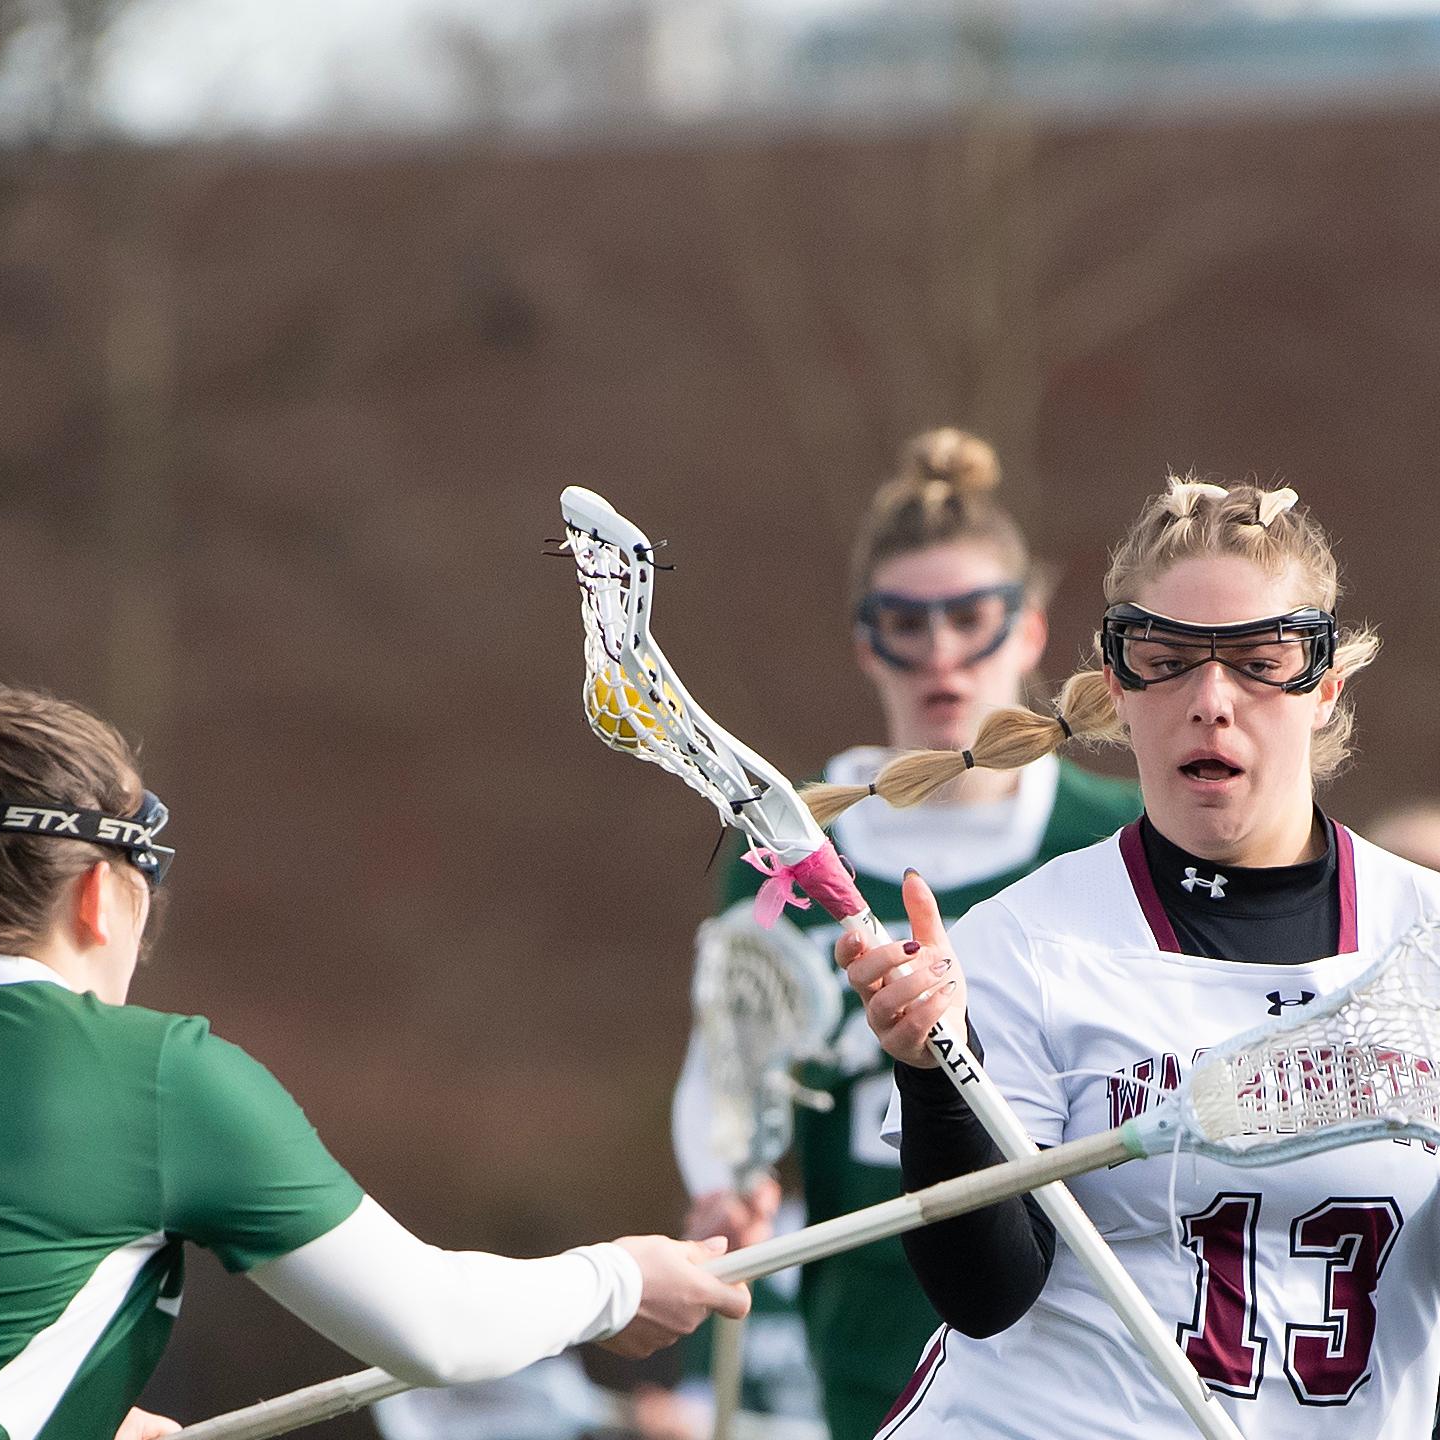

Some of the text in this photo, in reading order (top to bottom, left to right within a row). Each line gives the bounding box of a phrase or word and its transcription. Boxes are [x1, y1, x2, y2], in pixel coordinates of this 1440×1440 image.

[2, 805, 80, 834] STX
[97, 817, 153, 848] STX
[1176, 1192, 1404, 1406] 13
